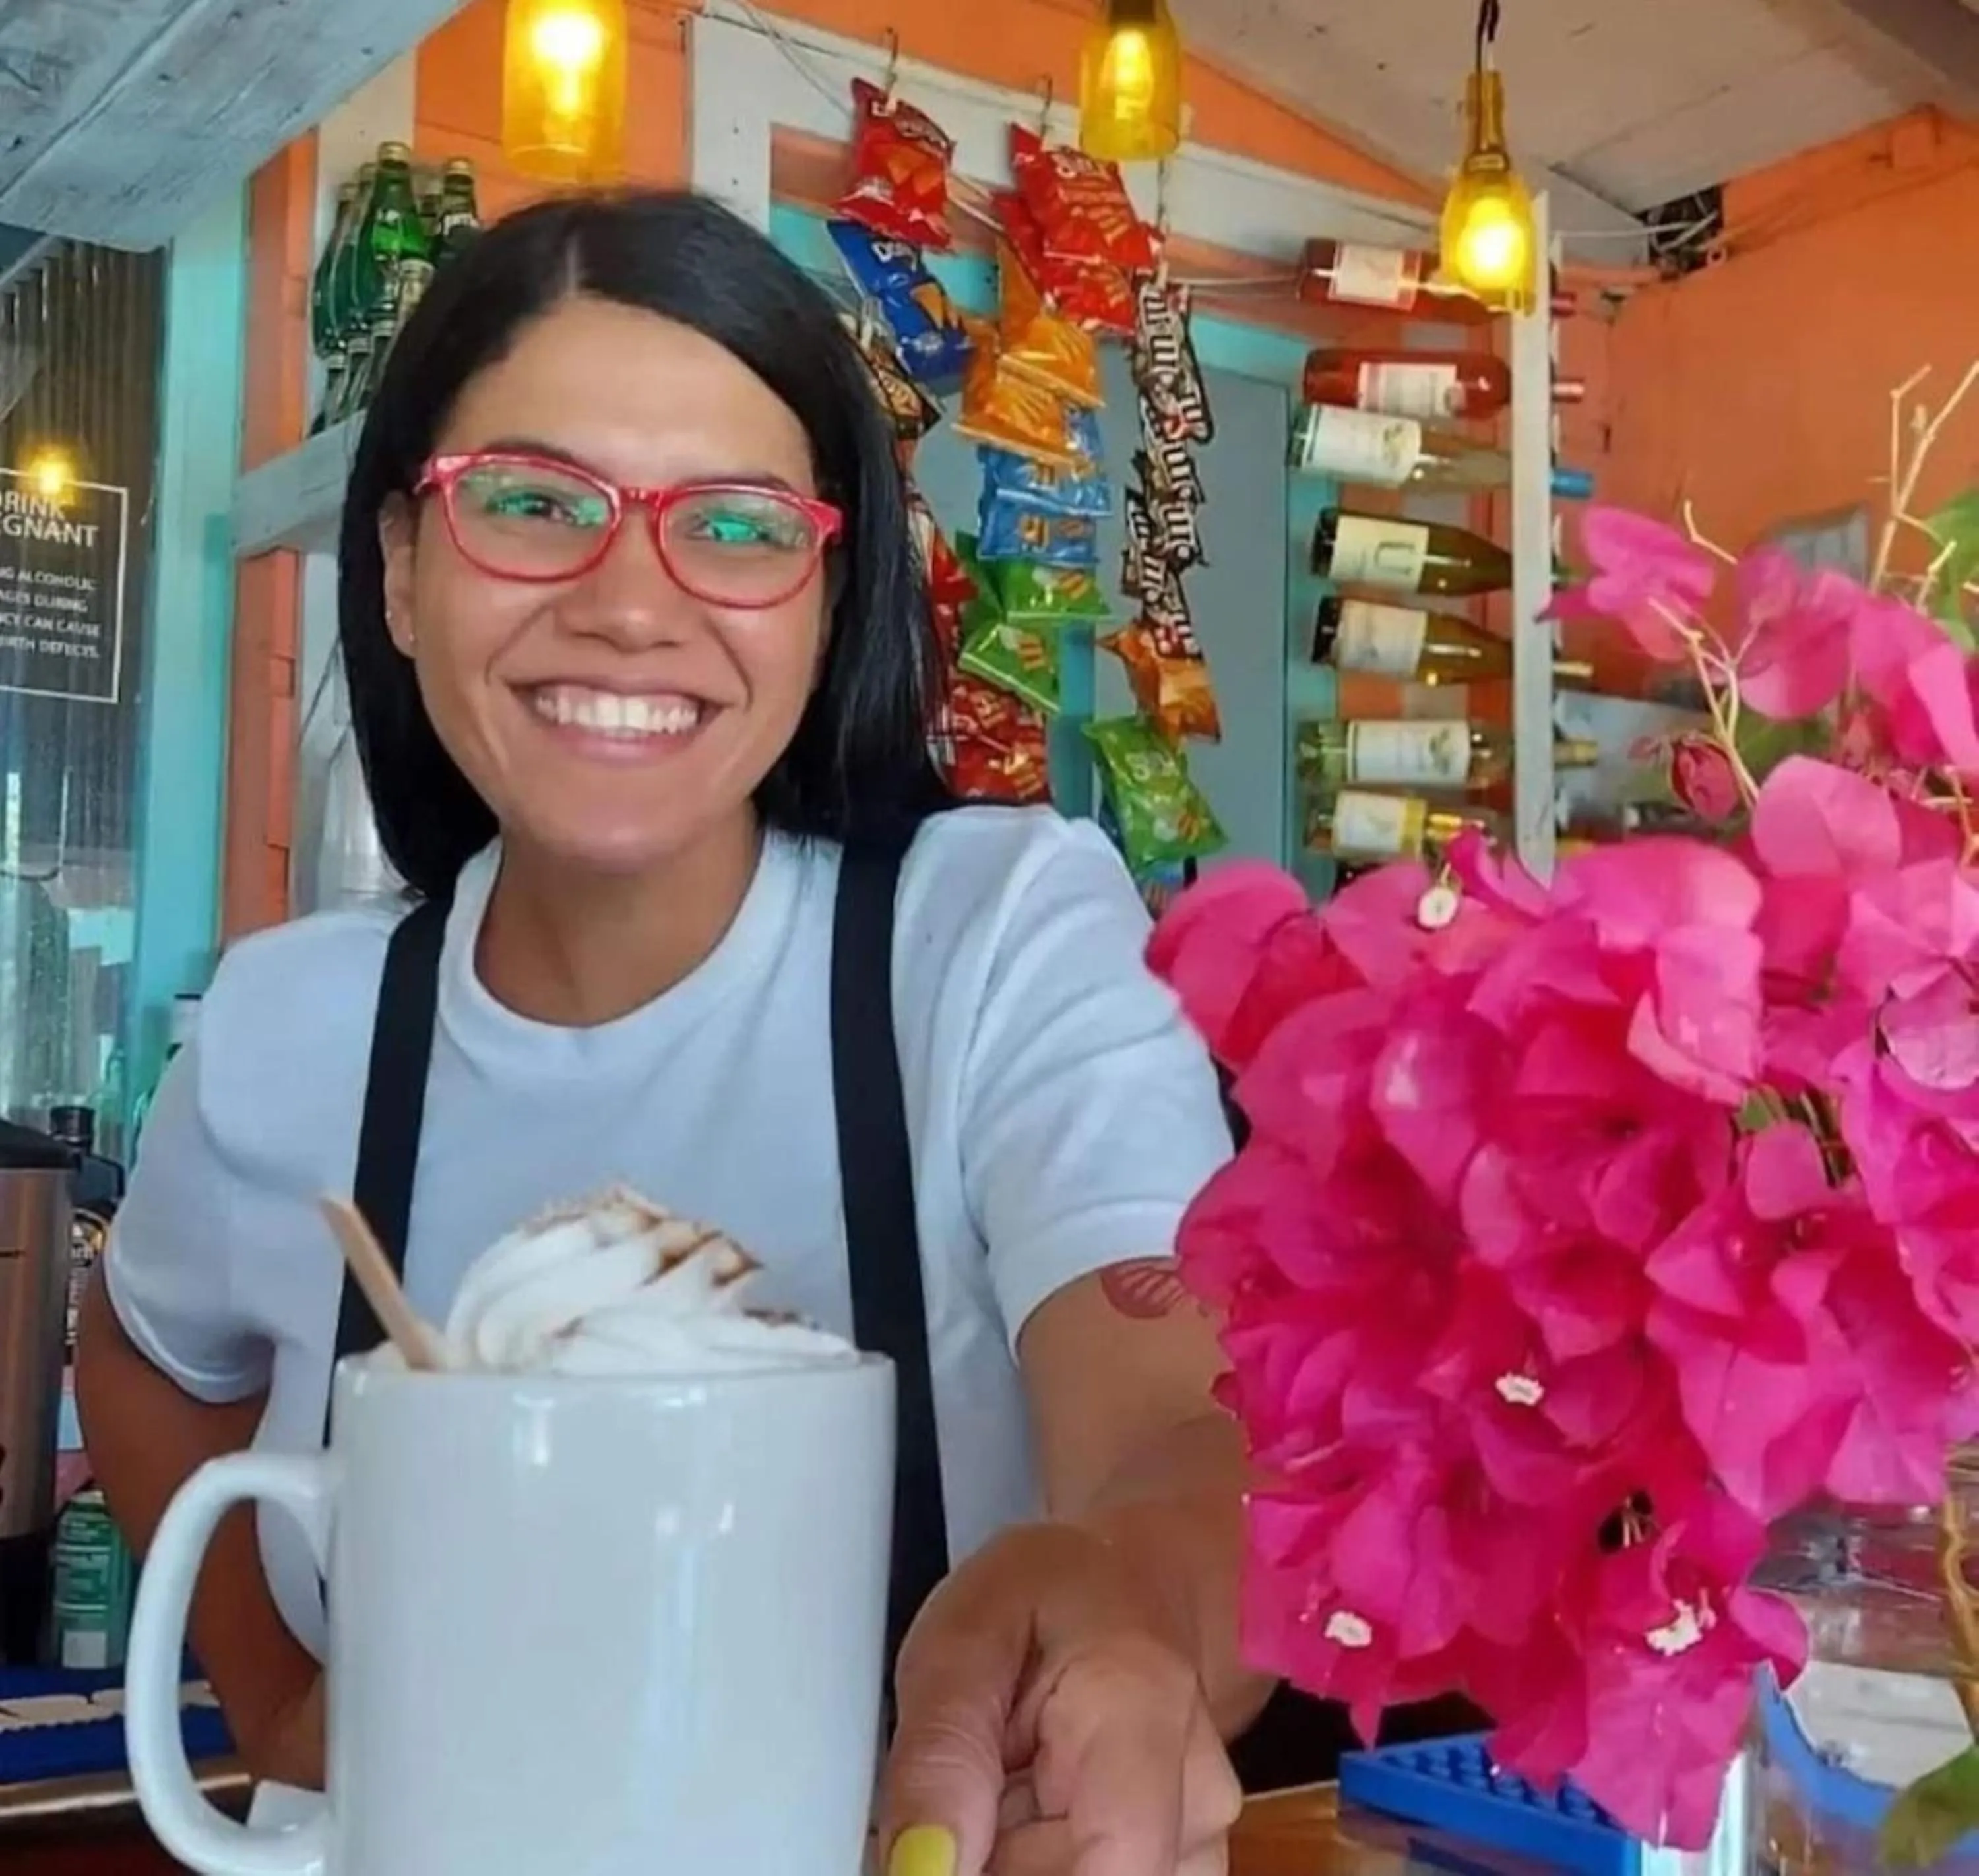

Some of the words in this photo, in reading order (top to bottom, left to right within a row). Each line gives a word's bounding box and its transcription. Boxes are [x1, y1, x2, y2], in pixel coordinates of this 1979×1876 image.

[0, 489, 65, 520] RINK
[0, 511, 99, 547] GNANT
[24, 615, 53, 631] CAN
[56, 618, 100, 637] CAUSE
